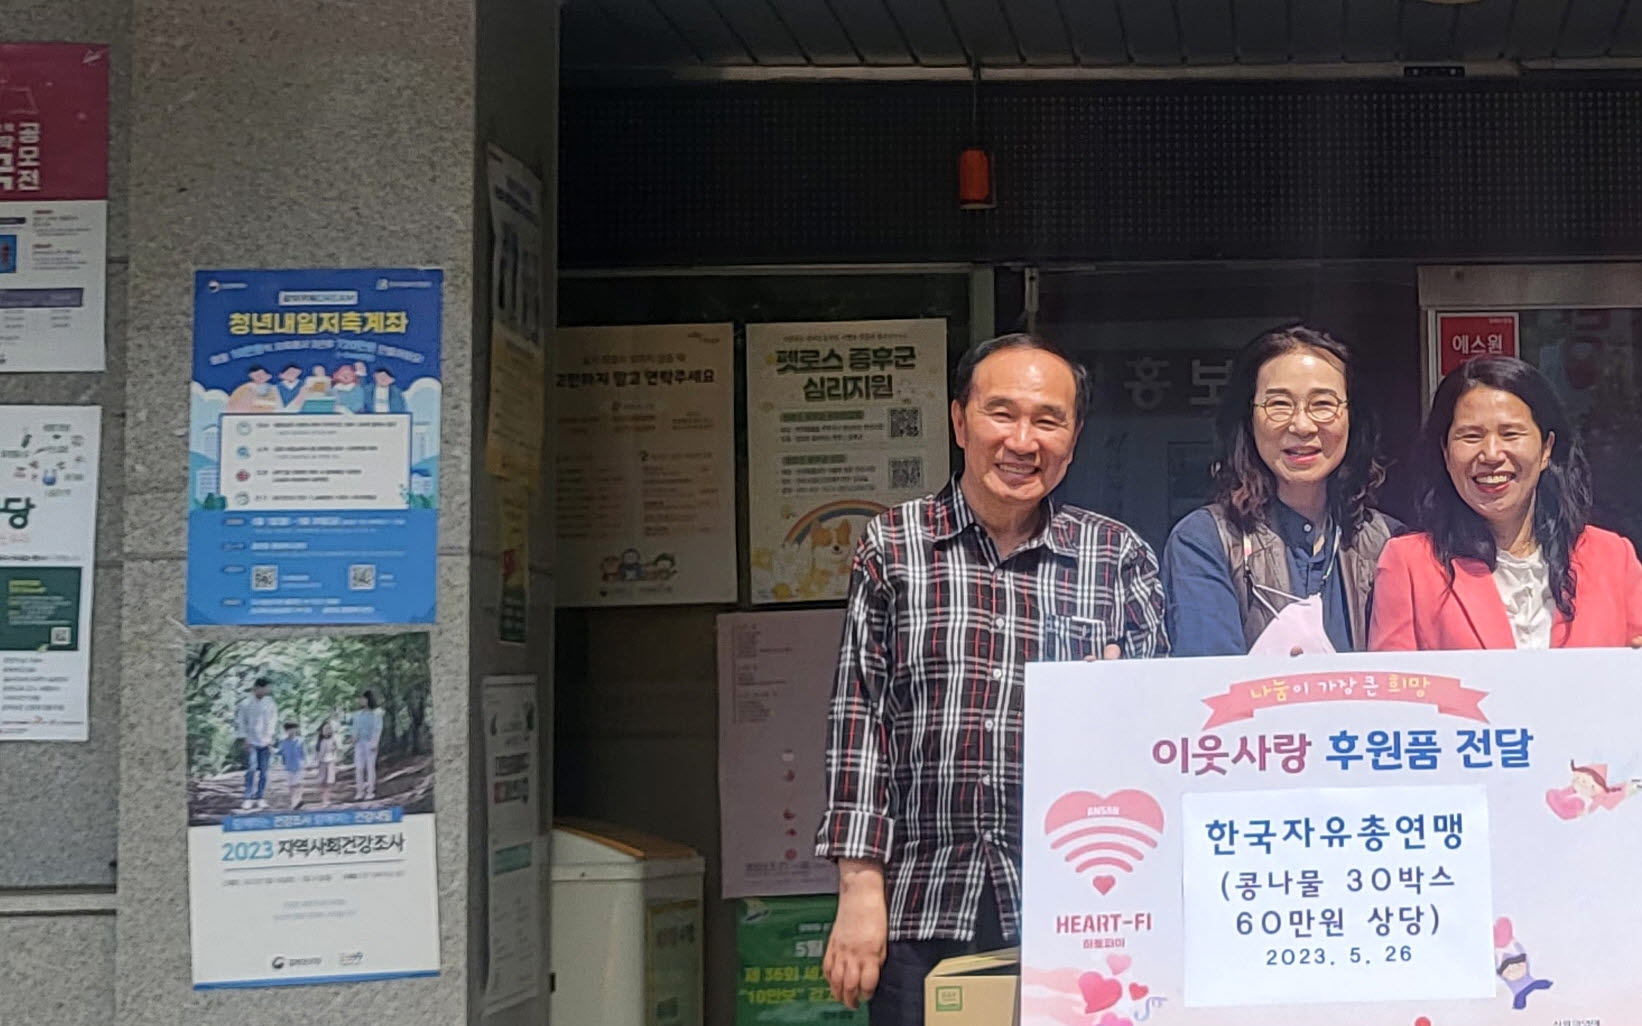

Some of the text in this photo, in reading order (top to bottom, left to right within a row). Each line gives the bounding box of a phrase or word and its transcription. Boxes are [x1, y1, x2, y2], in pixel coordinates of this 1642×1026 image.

[229, 311, 408, 335] 청년내일저축계좌
[849, 346, 916, 371] 증후군
[803, 374, 893, 401] 심리지원
[1250, 675, 1431, 701] 나눔이 가장 큰 희망
[1152, 728, 1534, 776] 이웃사랑 후원품 전달
[221, 832, 405, 862] 2023 지역사회건강조사
[1205, 812, 1463, 856] 한국자유총연맹
[1220, 865, 1455, 901] (콩나물 30박스
[1056, 912, 1152, 934] HEART-FI
[1236, 903, 1440, 938] 60만원 상당)
[1266, 945, 1412, 966] 2023. 5. 26
